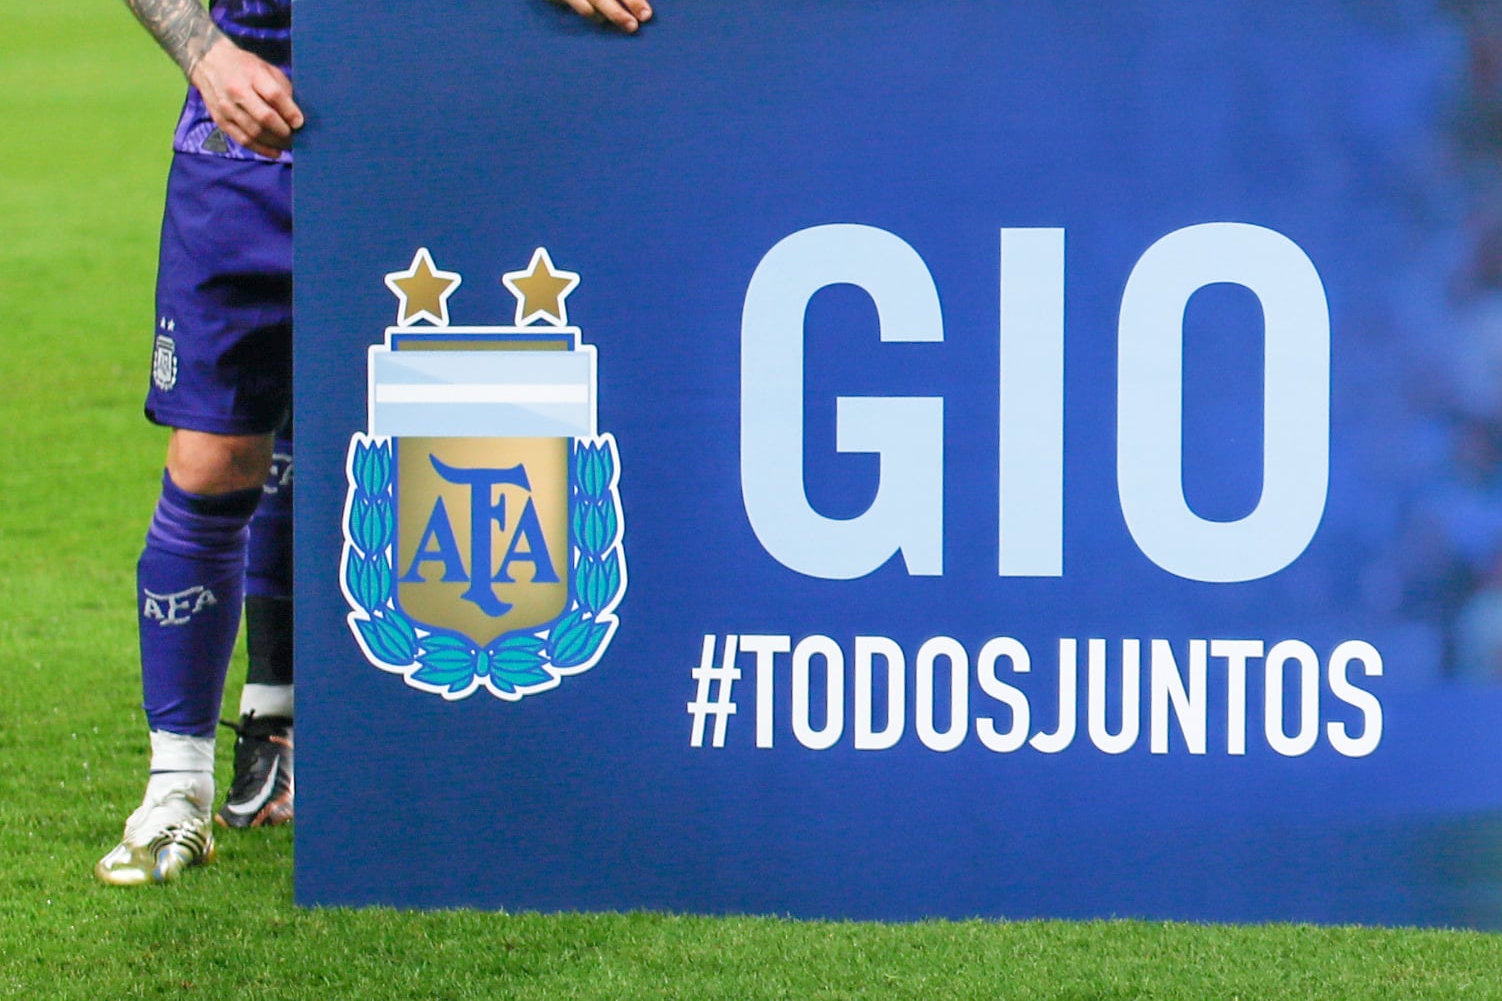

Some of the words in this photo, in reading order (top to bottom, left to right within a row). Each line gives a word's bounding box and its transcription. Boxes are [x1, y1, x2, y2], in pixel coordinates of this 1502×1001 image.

[740, 221, 1332, 584] GIO
[143, 585, 218, 627] AFA
[398, 453, 561, 618] AFA
[686, 634, 1384, 758] #TODOSJUNTOS
